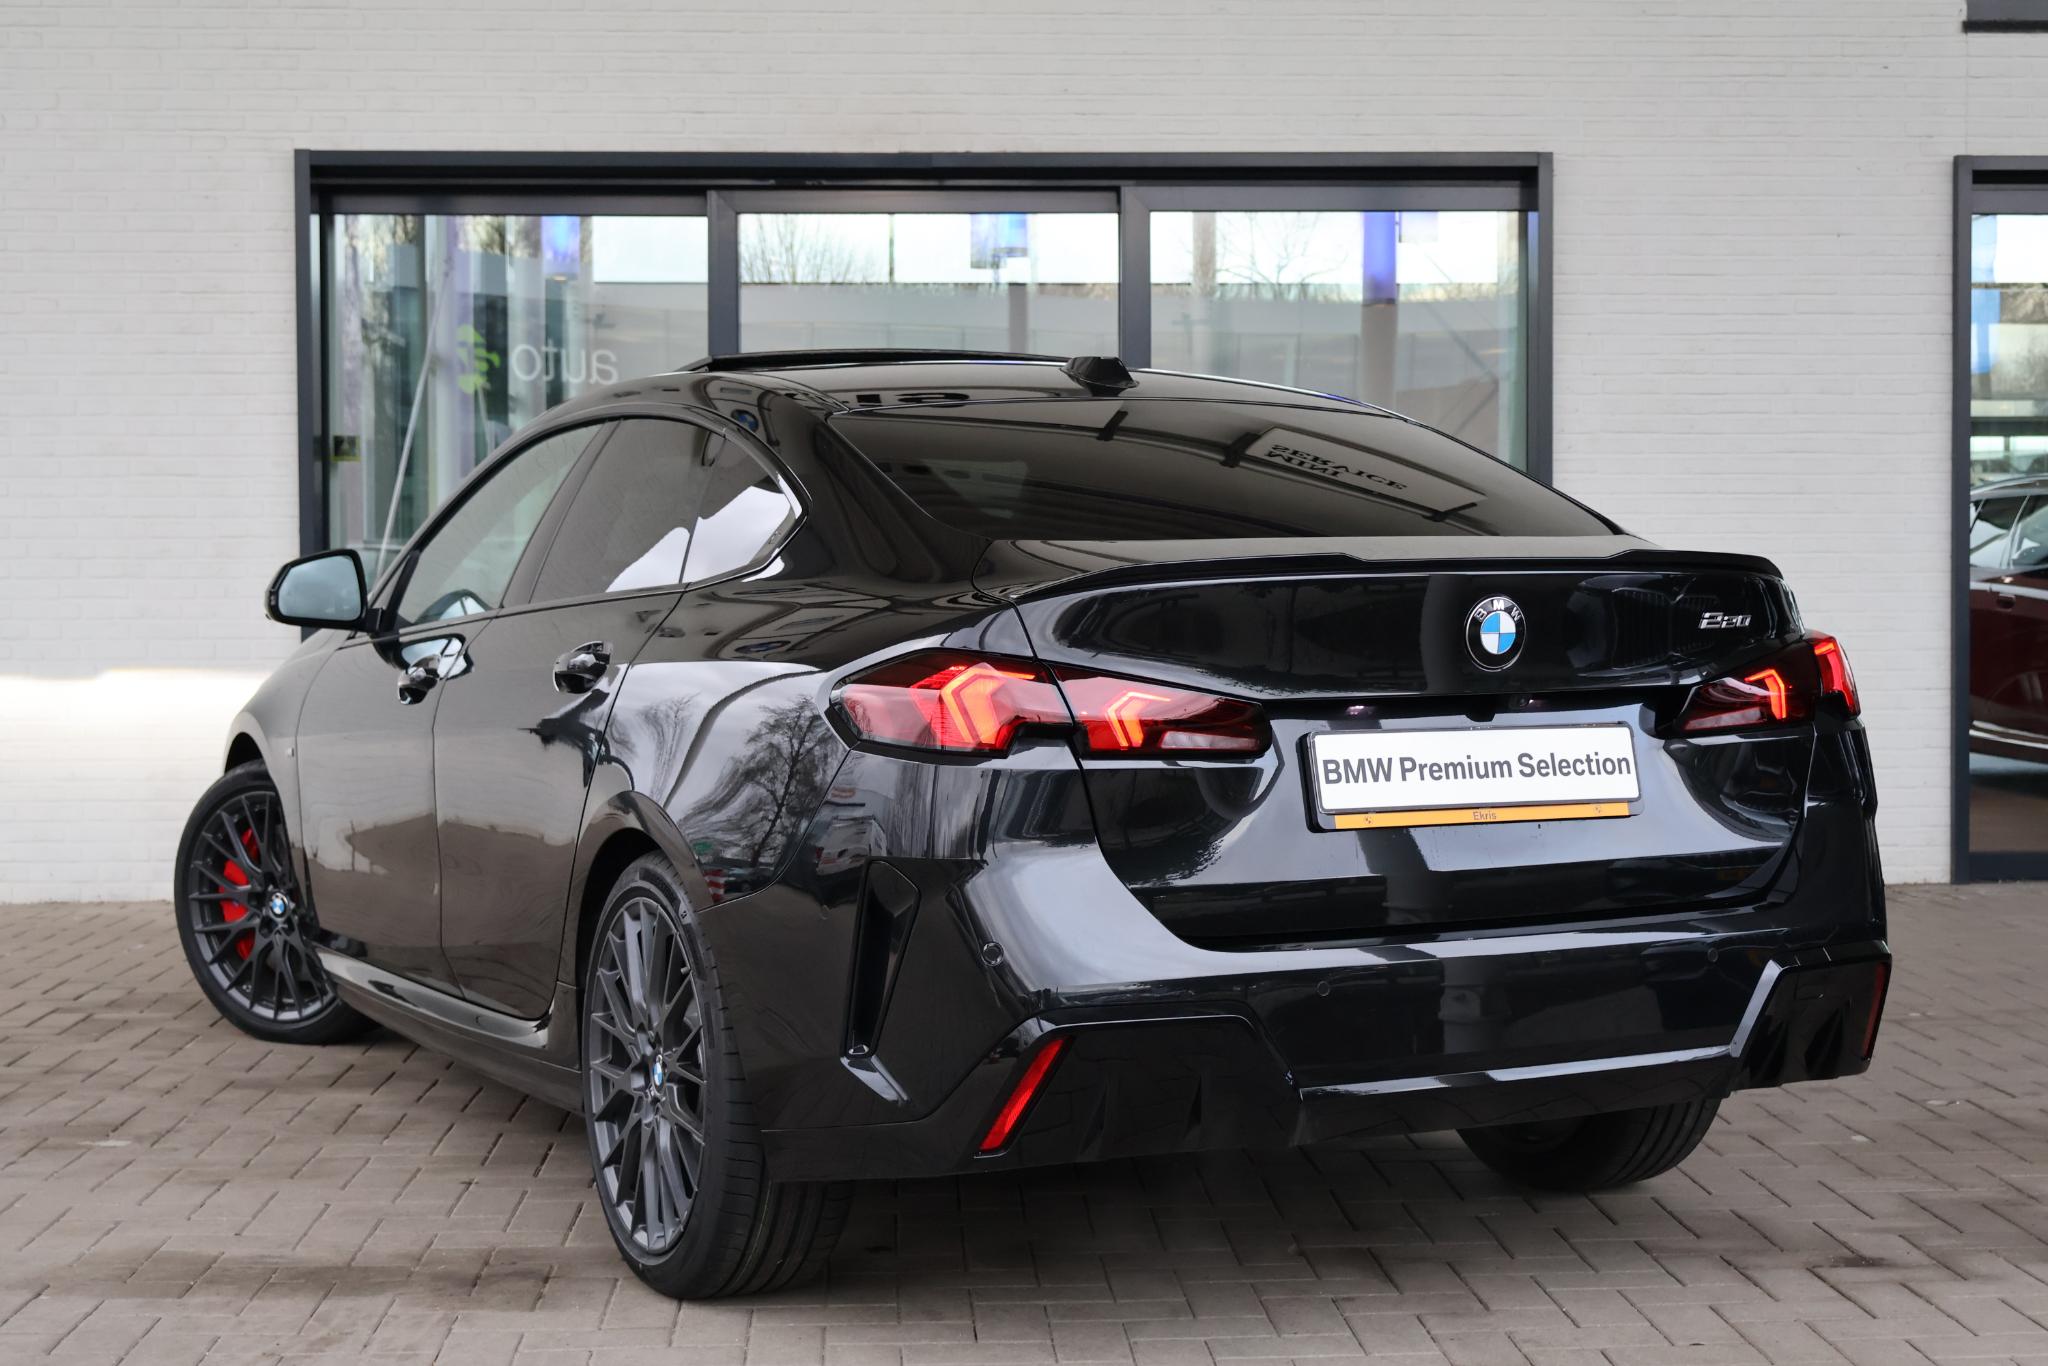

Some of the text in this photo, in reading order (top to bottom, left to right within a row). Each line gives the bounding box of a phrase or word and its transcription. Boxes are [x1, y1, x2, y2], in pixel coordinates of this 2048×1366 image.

[1474, 599, 1522, 622] BMW
[1322, 752, 1631, 785] BMW Premium Selection
[1472, 809, 1498, 821] Ekris
